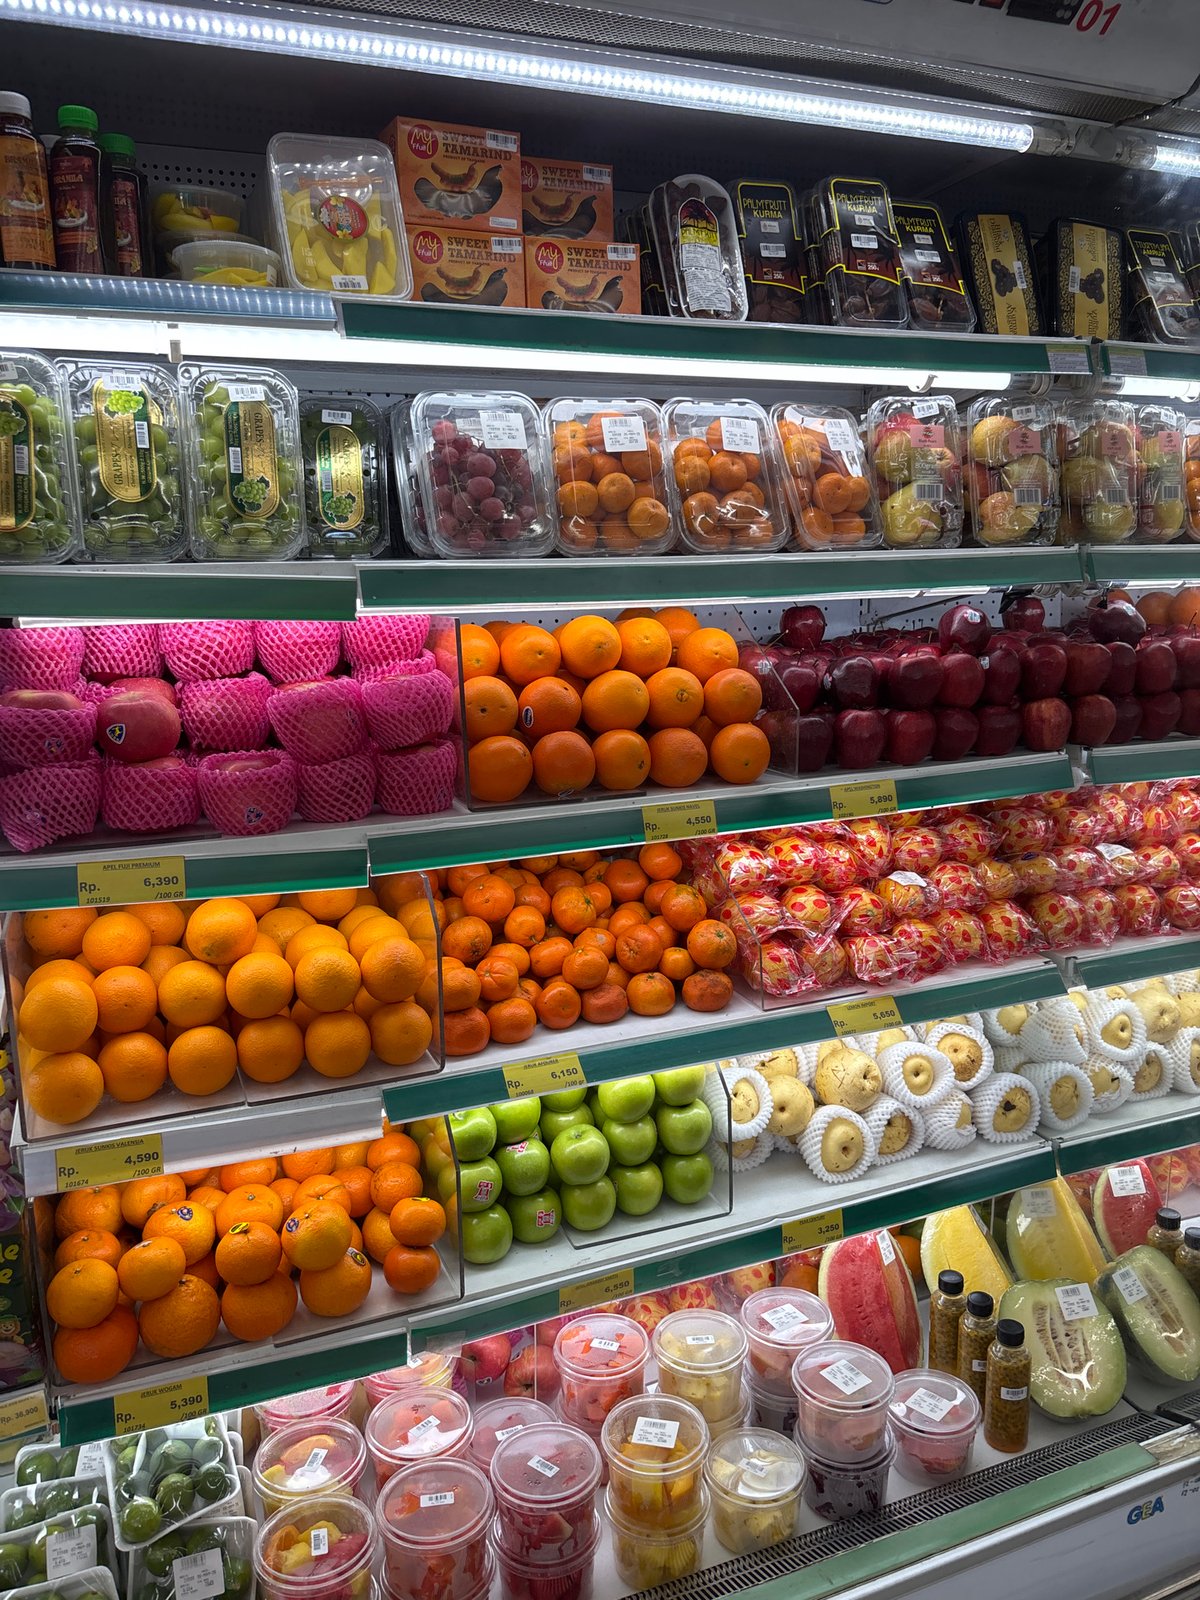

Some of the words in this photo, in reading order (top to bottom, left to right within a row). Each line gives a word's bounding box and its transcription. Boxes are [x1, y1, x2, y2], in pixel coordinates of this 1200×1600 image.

[1076, 0, 1121, 35] 01
[442, 130, 486, 145] SWEET
[442, 143, 512, 161] TAMARIND
[542, 166, 581, 178] SWEET
[542, 178, 605, 192] TAMARIND
[753, 210, 783, 218] KURMA
[847, 204, 878, 214] KURMA
[905, 225, 934, 234] KURMA
[448, 236, 489, 249] SWEET
[448, 248, 516, 263] TAMARIND
[567, 246, 607, 258] SWEET
[567, 257, 632, 272] TAMARIND
[254, 412, 264, 443] GRAPES
[112, 453, 123, 485] GRAPES
[833, 801, 847, 810] Rp.
[869, 795, 893, 805] 5,890
[645, 822, 660, 832] Rp.
[686, 816, 712, 826] 4,550
[79, 882, 100, 894] Rp.
[143, 876, 179, 888] 6,390
[86, 896, 111, 904] 101519
[155, 892, 172, 900] /100
[833, 1020, 848, 1028] Rp.
[872, 1010, 895, 1020] 5,650
[507, 1080, 524, 1089] Rp.
[551, 1068, 578, 1080] 6,150
[116, 1139, 144, 1147] VALENSIA
[59, 1166, 79, 1178] Rp.
[124, 1152, 159, 1165] 4,590
[65, 1179, 89, 1188] 101674
[132, 1168, 150, 1177] /100
[784, 1236, 796, 1244] Rp.
[818, 1224, 840, 1235] 3,250
[604, 1281, 630, 1293] 6,550
[141, 1390, 157, 1398] JERUK
[116, 1412, 135, 1424] Rp.
[170, 1394, 202, 1410] 5,390
[1, 1416, 13, 1424] Rp.
[124, 1423, 146, 1433] 101734
[181, 1411, 196, 1420] /100
[1127, 1496, 1165, 1525] GEA
